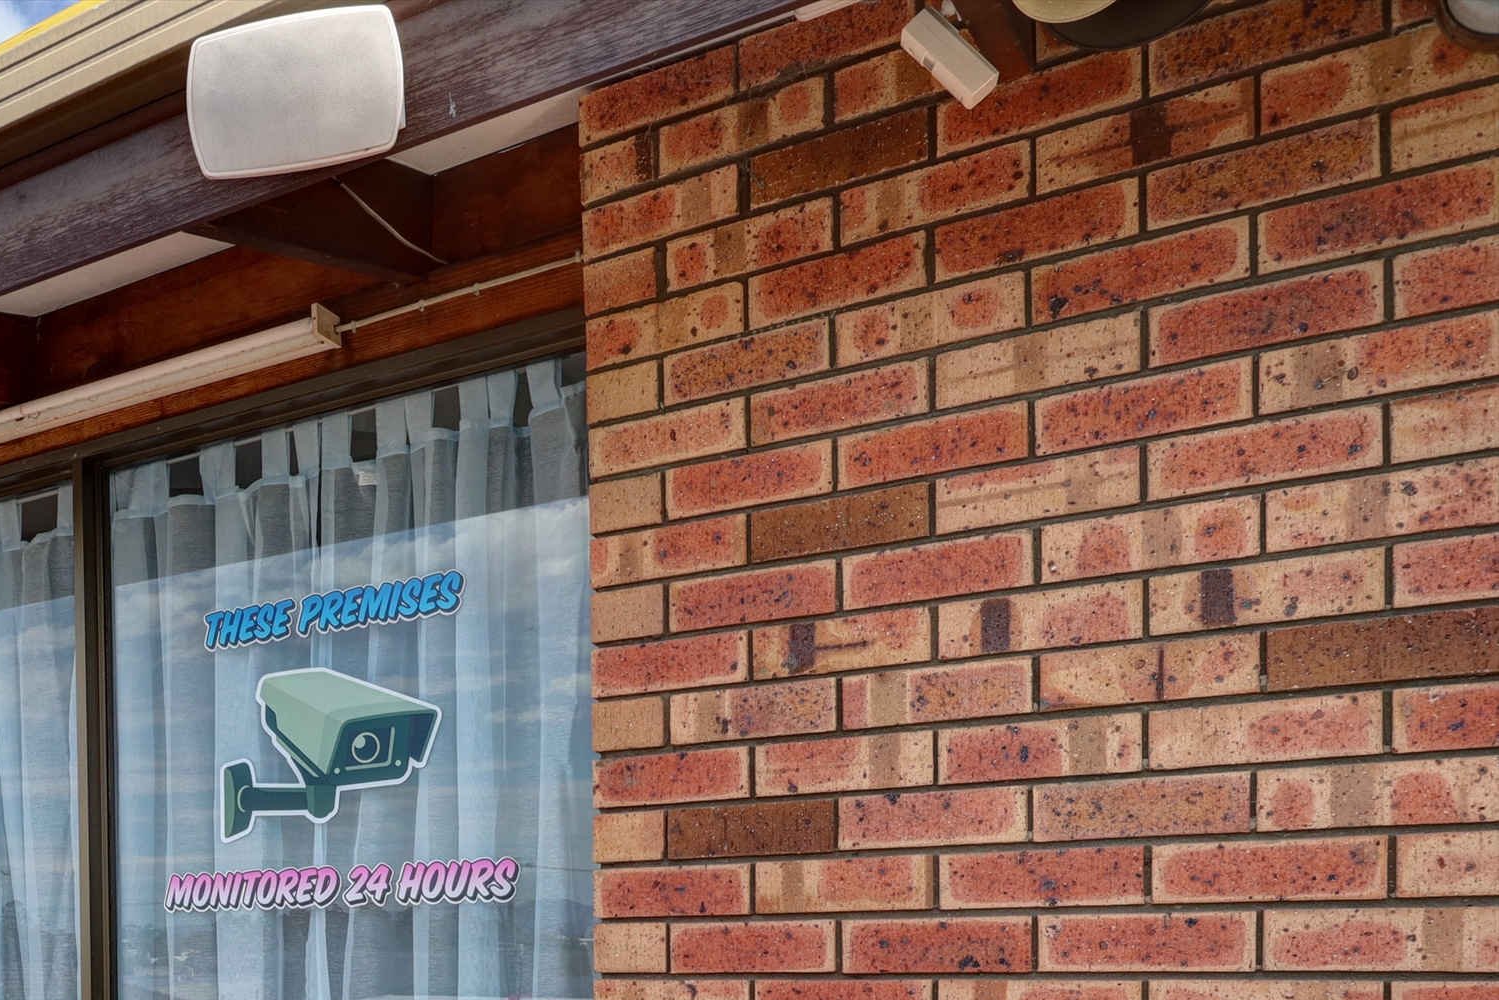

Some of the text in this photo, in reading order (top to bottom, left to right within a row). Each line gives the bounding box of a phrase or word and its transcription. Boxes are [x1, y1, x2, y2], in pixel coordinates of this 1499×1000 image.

[203, 568, 466, 653] THESE PREMISES
[164, 855, 522, 913] MONITORED 24 HOURS
